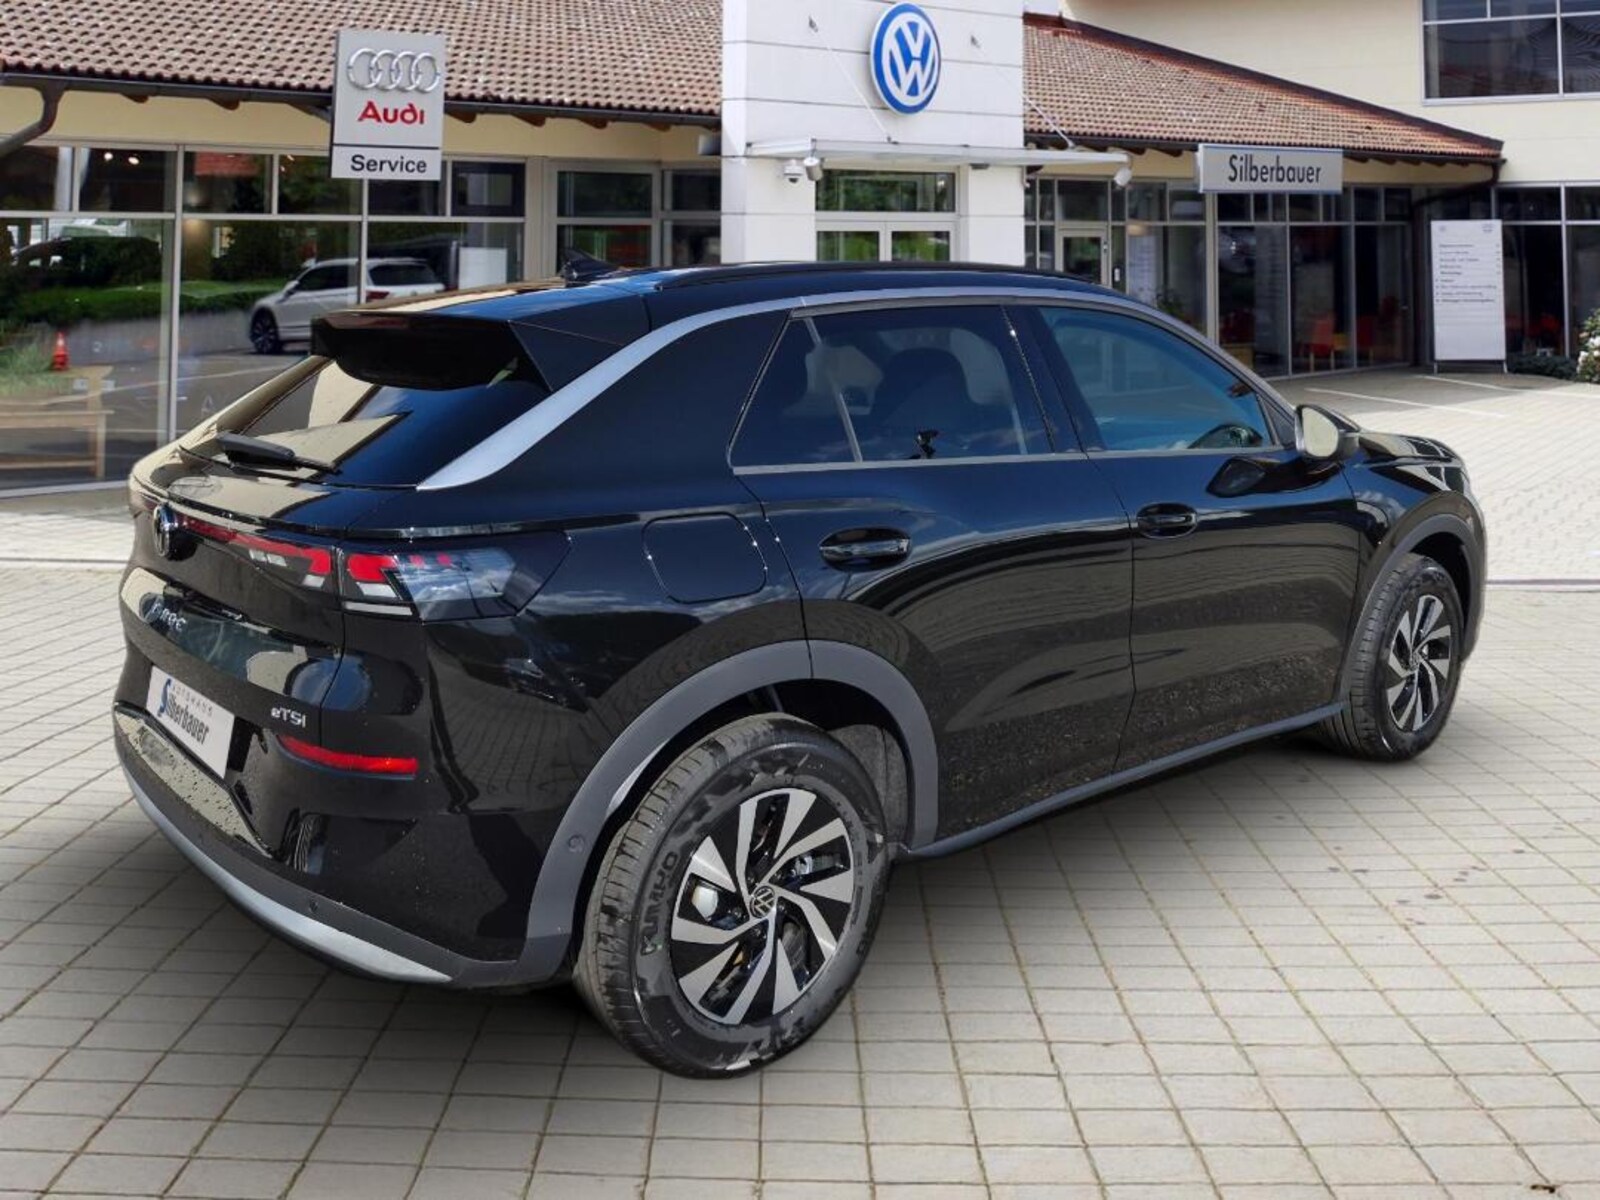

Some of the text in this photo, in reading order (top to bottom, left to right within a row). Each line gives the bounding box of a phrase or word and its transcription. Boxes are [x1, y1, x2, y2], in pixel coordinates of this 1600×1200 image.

[357, 100, 425, 125] Audi
[351, 154, 427, 173] Service
[1228, 154, 1322, 184] Silberbauer
[271, 706, 306, 728] eTSI
